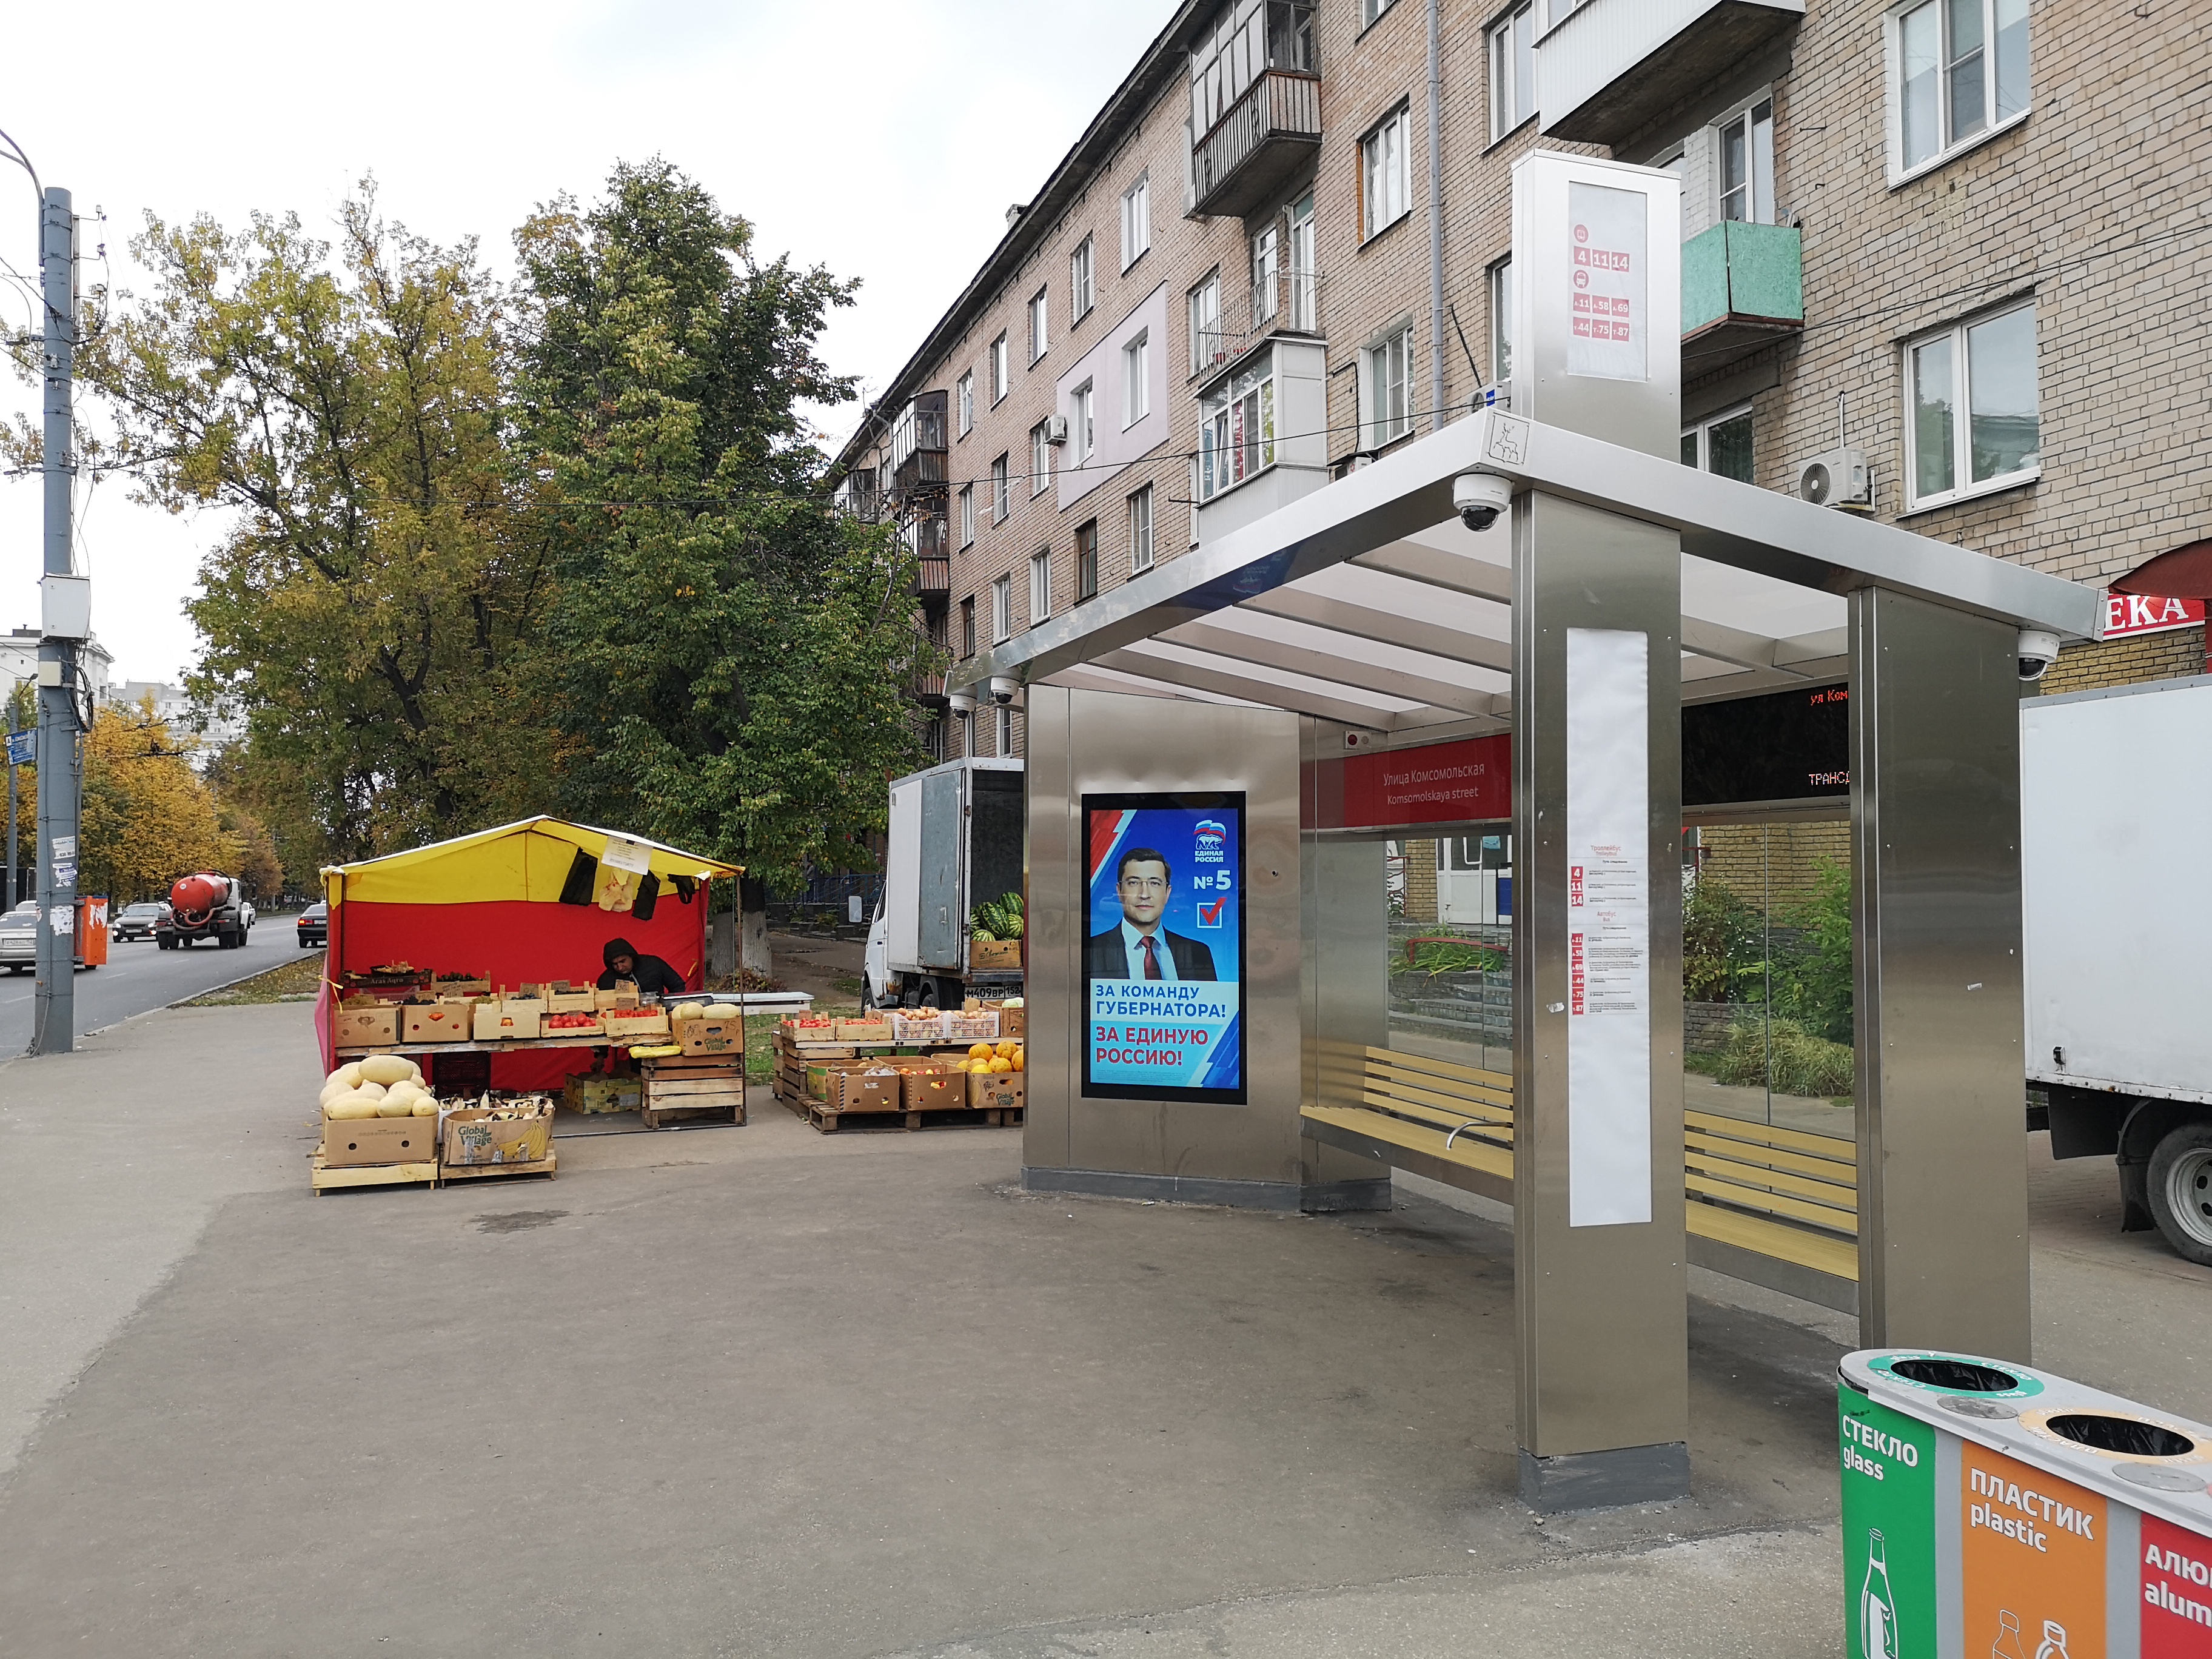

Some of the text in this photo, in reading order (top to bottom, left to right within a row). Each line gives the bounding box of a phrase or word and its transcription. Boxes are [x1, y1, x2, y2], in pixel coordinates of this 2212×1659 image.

[1578, 250, 1629, 269] 4 11 14
[1810, 689, 1848, 706] ул Ком
[1383, 763, 1485, 786] Улица Комсомольская
[1387, 786, 1479, 805] Komsomolskaya street
[1574, 868, 1580, 877] 4
[1571, 882, 1582, 891] 11
[1572, 895, 1583, 905] 14
[966, 988, 1004, 998] М409ВР
[1096, 985, 1199, 1000] ЗА КОМАНДУ
[1096, 1001, 1226, 1018] ГУБЕРНАТОРА!
[1096, 1027, 1208, 1046] ЗА ЕДИНУЮ
[1096, 1048, 1183, 1066] РОССИЮ!
[458, 1125, 489, 1136] Global
[1842, 1415, 1919, 1467] СТЕКЛО
[1843, 1445, 1885, 1481] glass
[1970, 1467, 2094, 1541] ПЛАСТИК
[1971, 1503, 2048, 1553] plastic
[2145, 1544, 2212, 1589] АЛЮ
